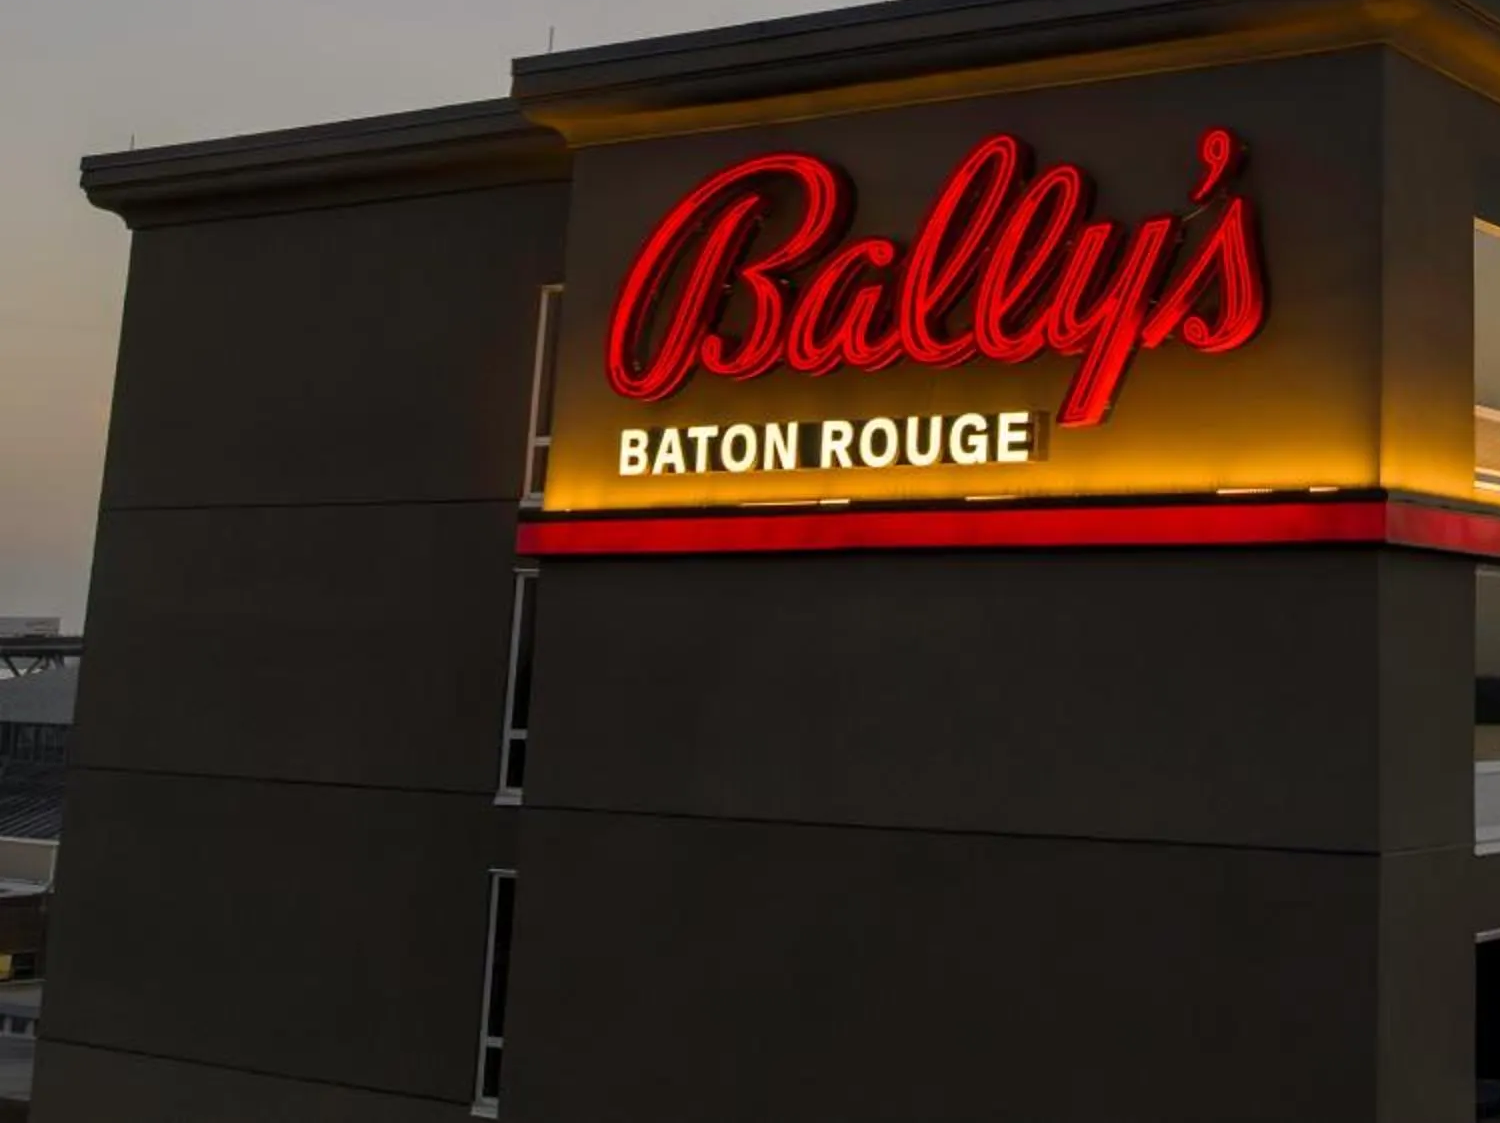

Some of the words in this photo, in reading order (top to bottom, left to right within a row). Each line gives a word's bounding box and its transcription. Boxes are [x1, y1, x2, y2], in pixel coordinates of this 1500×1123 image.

[607, 127, 1264, 427] Bally's
[618, 421, 800, 476] BATON
[819, 411, 1031, 469] ROUGE
